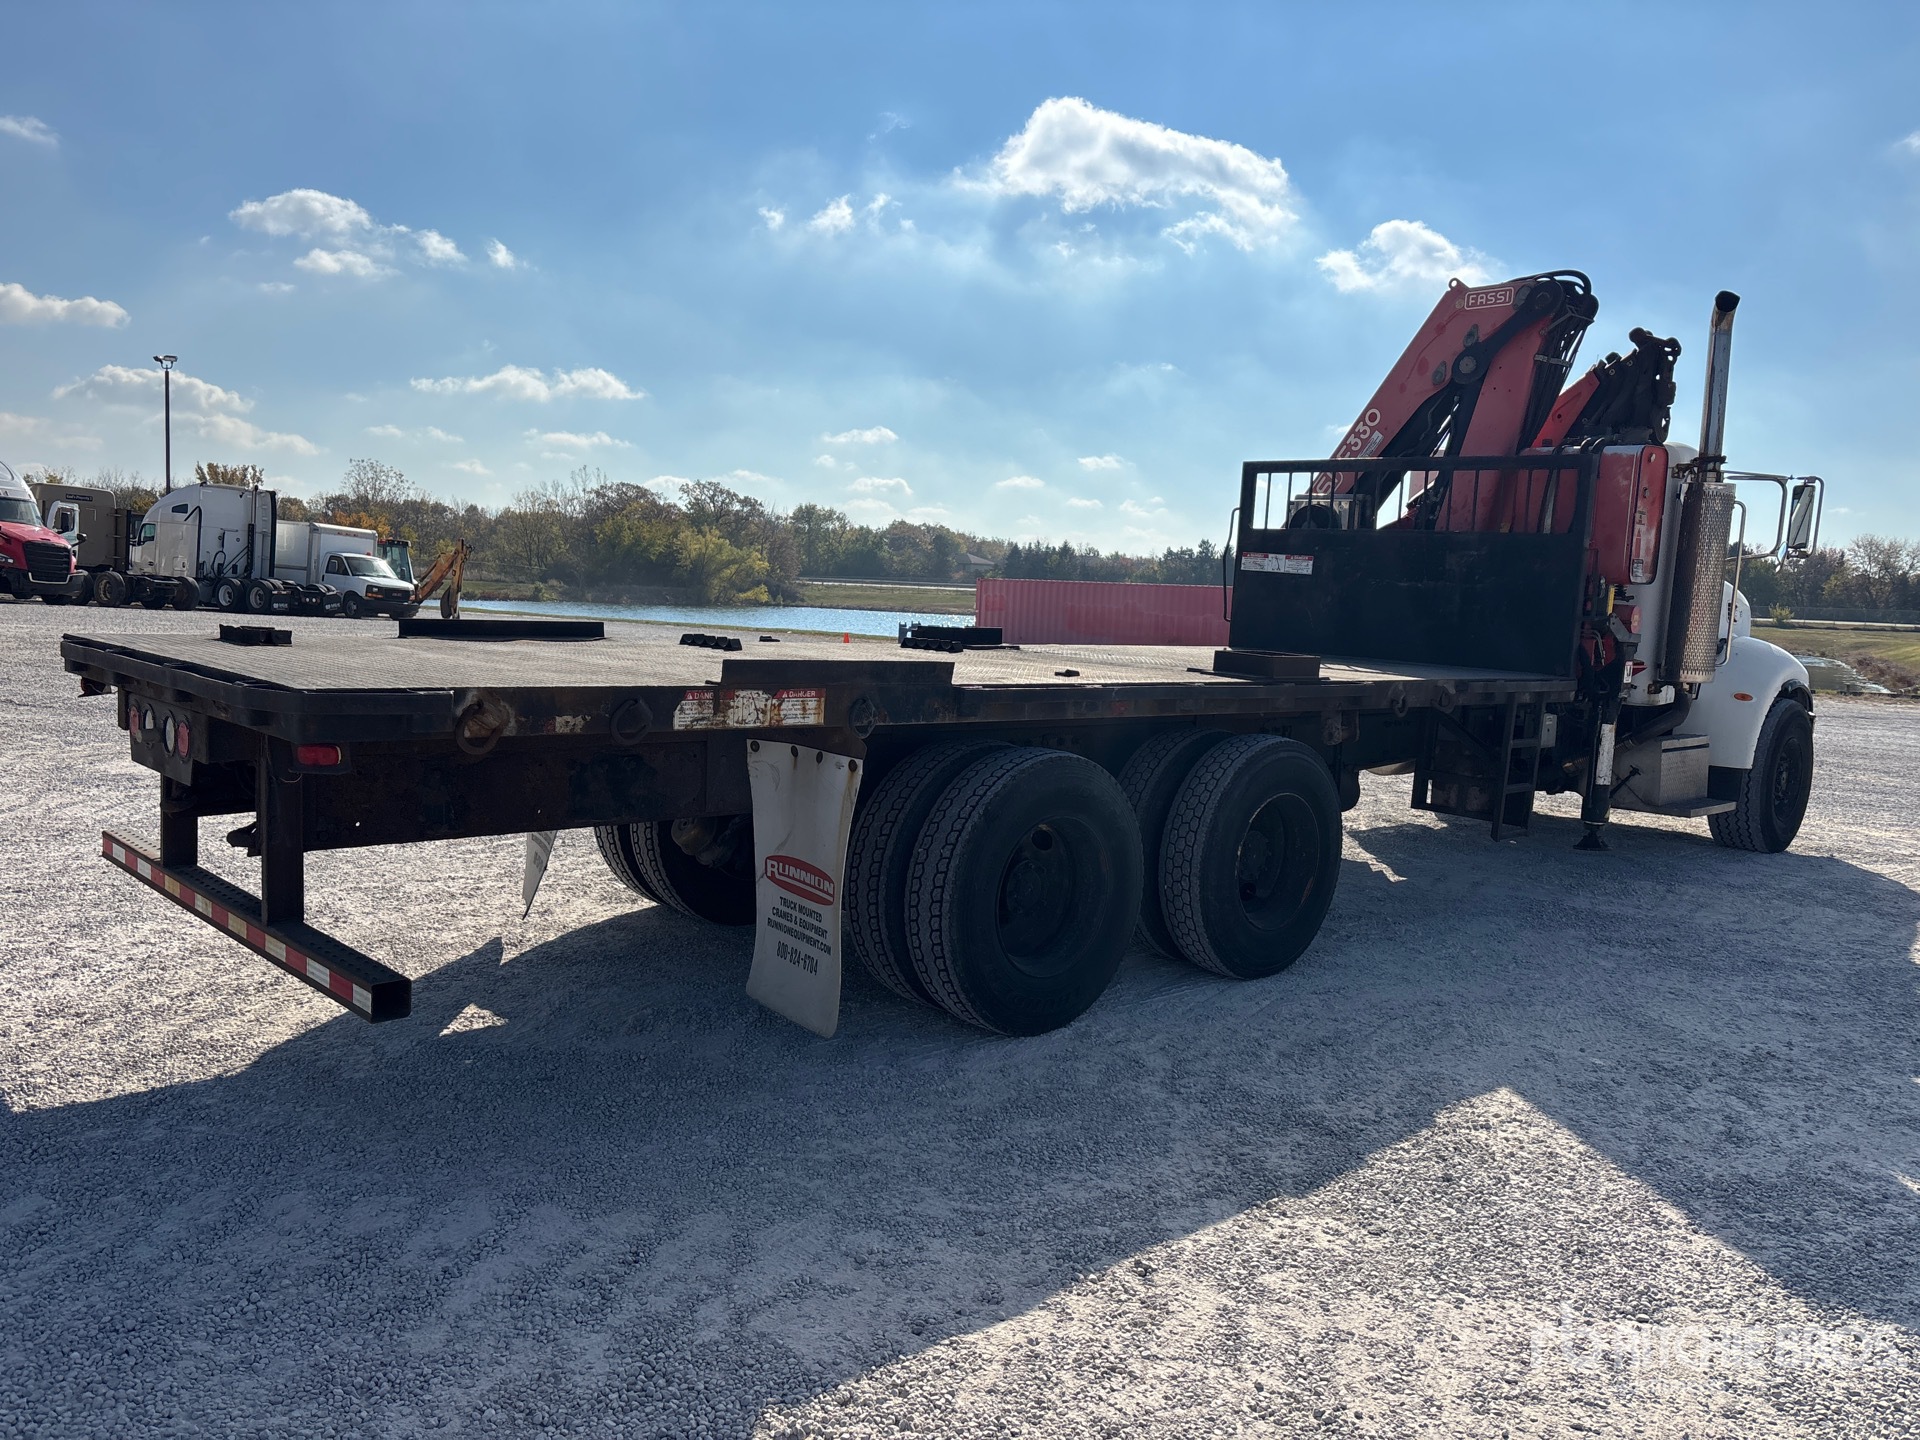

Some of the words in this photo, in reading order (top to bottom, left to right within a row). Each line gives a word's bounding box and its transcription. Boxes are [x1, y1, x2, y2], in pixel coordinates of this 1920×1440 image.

[1469, 291, 1510, 306] FASSI
[766, 859, 834, 897] RUNNION
[772, 906, 793, 923] CRANES
[794, 916, 798, 926] &
[799, 917, 828, 940] EQUIPMENT
[780, 896, 797, 912] TRUCK
[798, 904, 822, 923] MOUNTED
[767, 917, 832, 956] RUNNIONEQUIPMENT.COM
